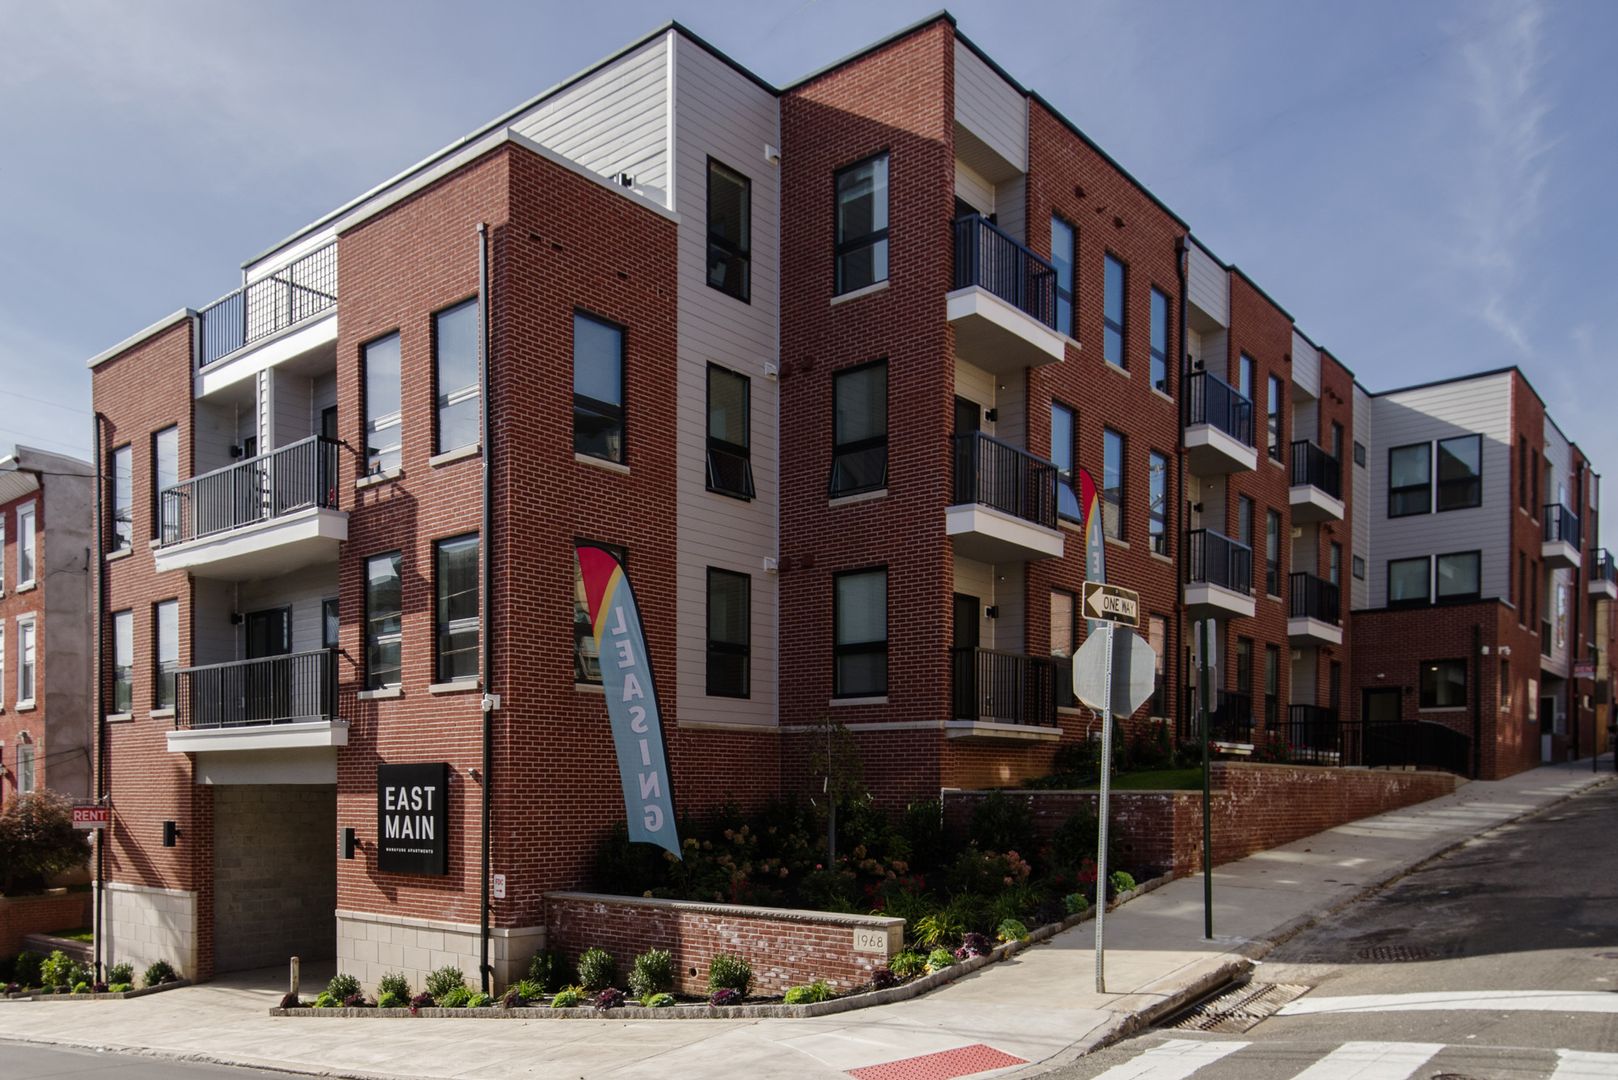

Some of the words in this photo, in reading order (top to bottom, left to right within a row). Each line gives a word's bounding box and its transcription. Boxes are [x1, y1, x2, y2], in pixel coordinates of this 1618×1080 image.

[1104, 596, 1119, 612] ONE
[1121, 600, 1135, 616] WAY
[385, 786, 436, 811] EAST
[73, 810, 105, 821] RENT
[385, 814, 435, 840] MAIN
[857, 933, 884, 949] 1968
